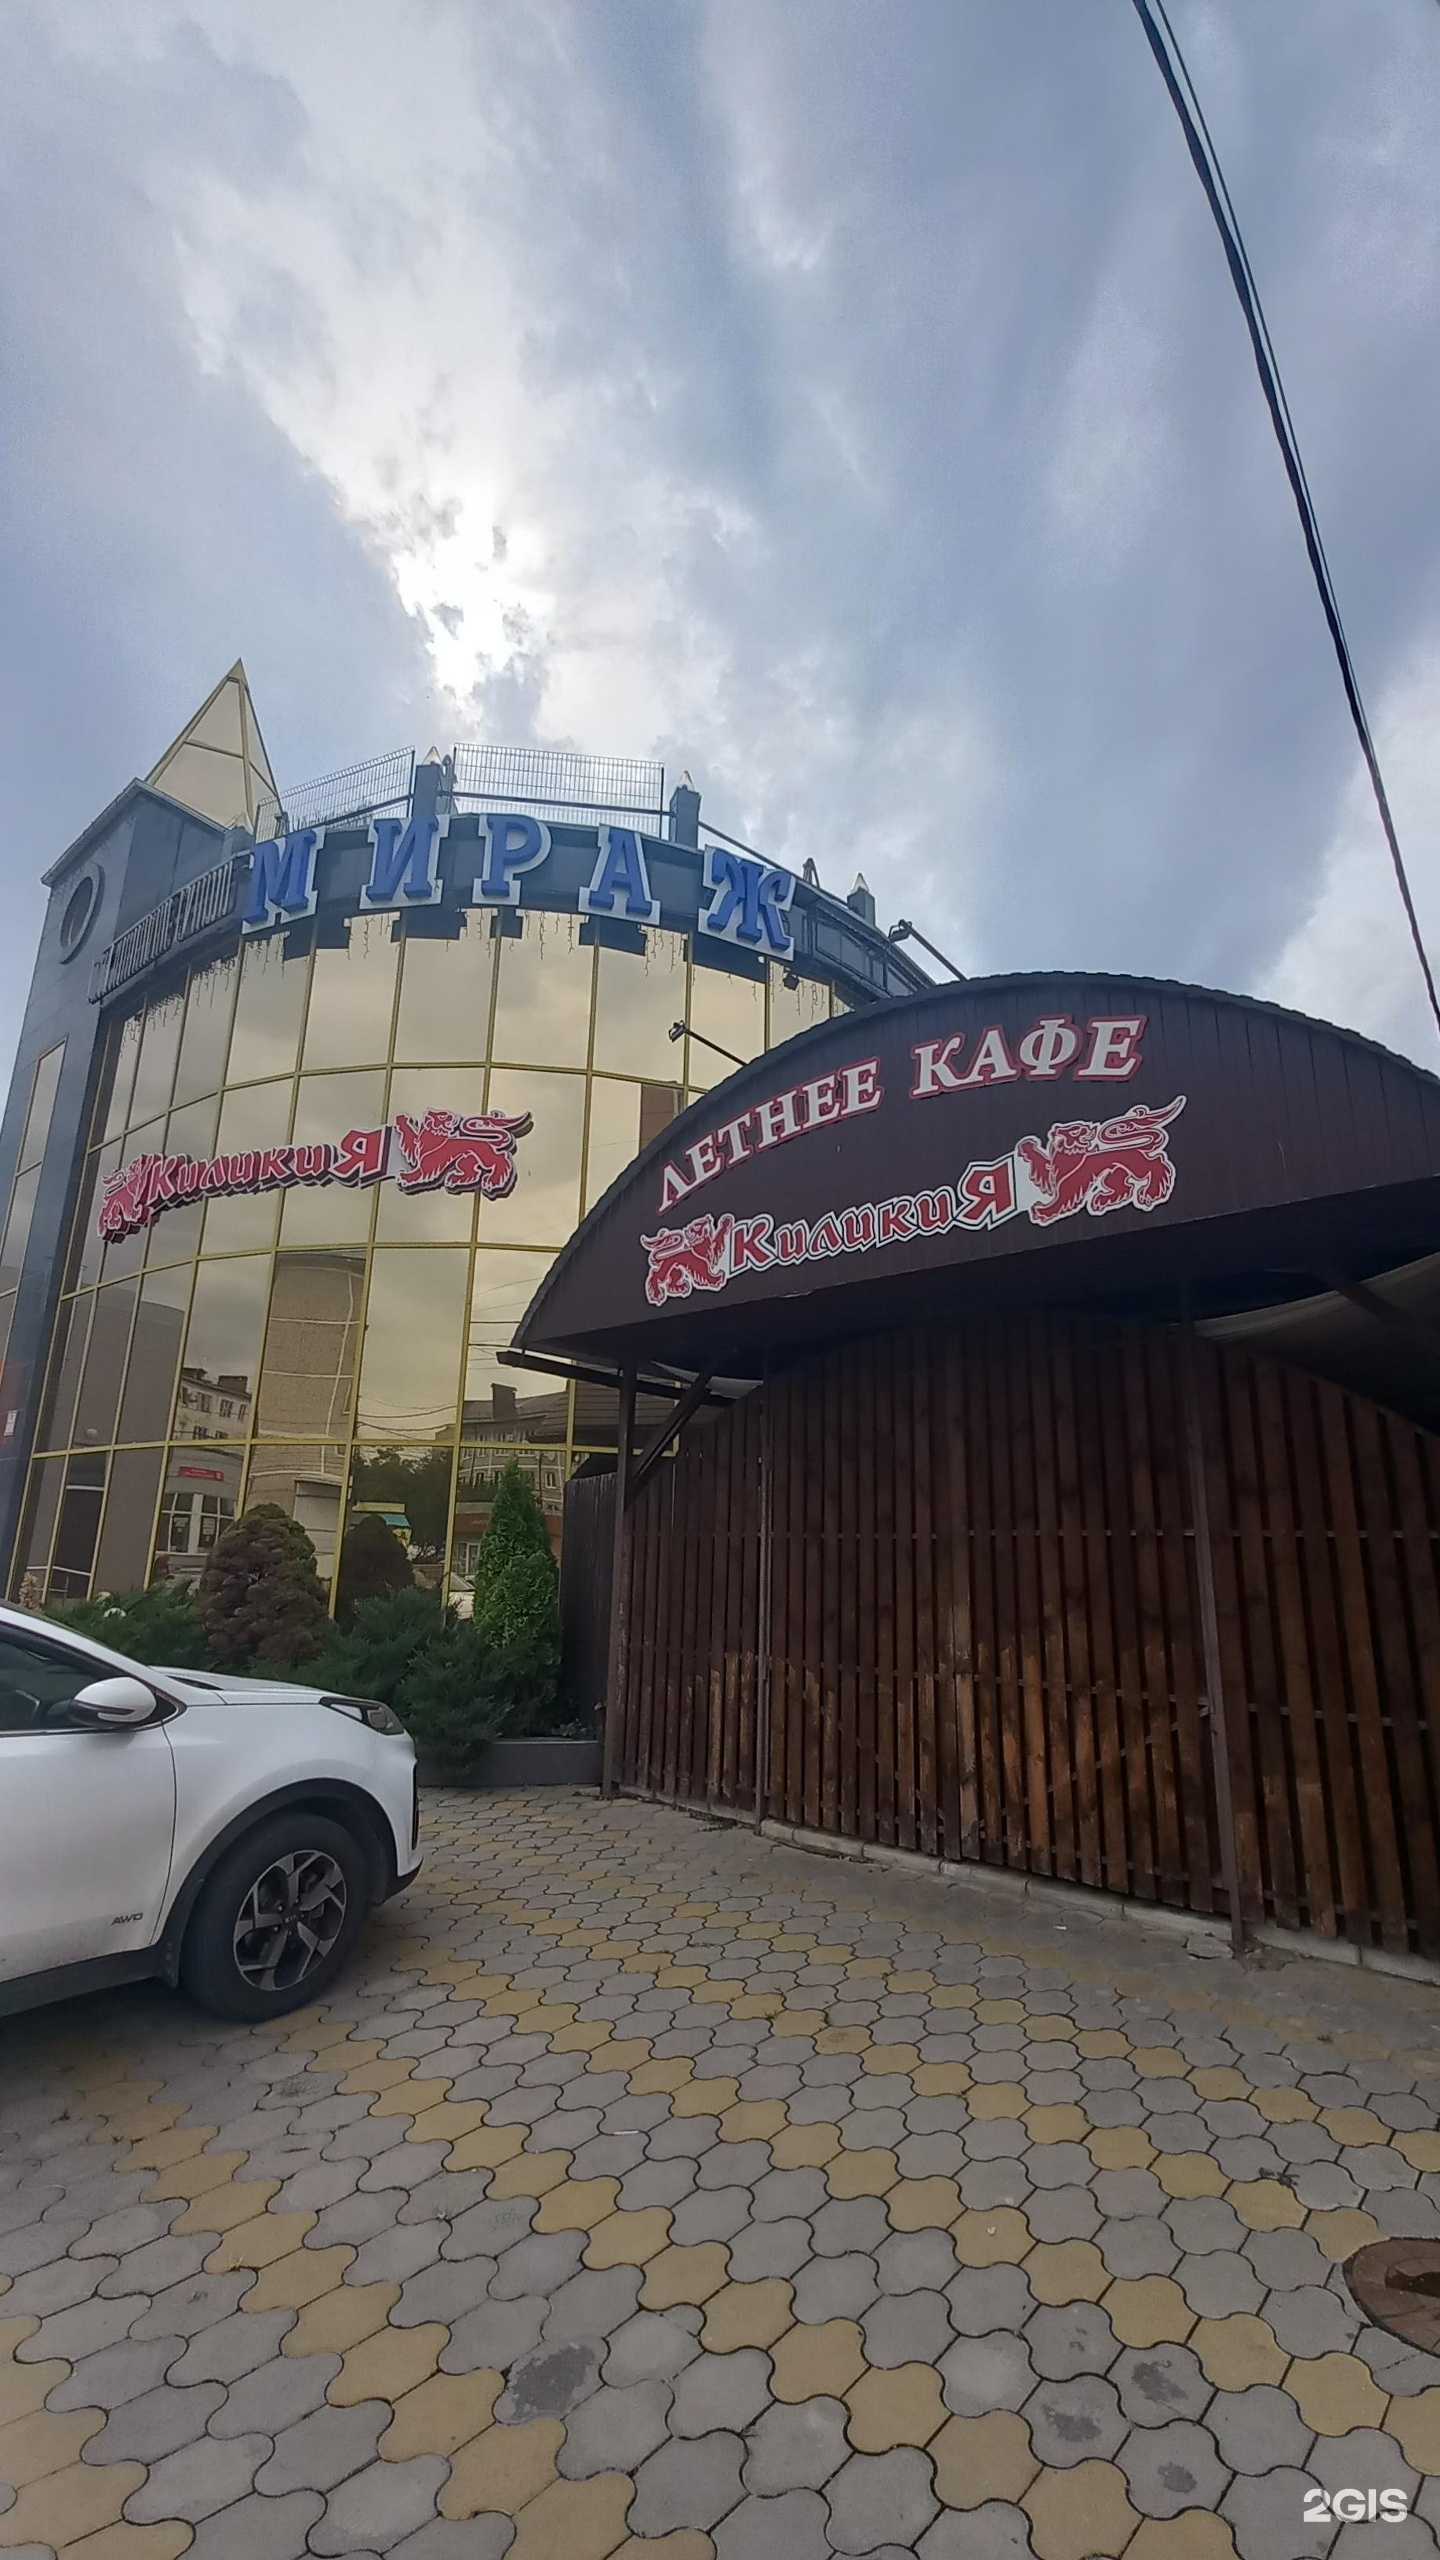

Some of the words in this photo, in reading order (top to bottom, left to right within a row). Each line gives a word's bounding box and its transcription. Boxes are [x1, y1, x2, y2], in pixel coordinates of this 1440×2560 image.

[242, 813, 796, 960] МИРАЖ
[657, 1057, 883, 1215] ЛЕТНЕЕ
[910, 1014, 1150, 1098] КАФЕ
[111, 1911, 144, 1927] AWD
